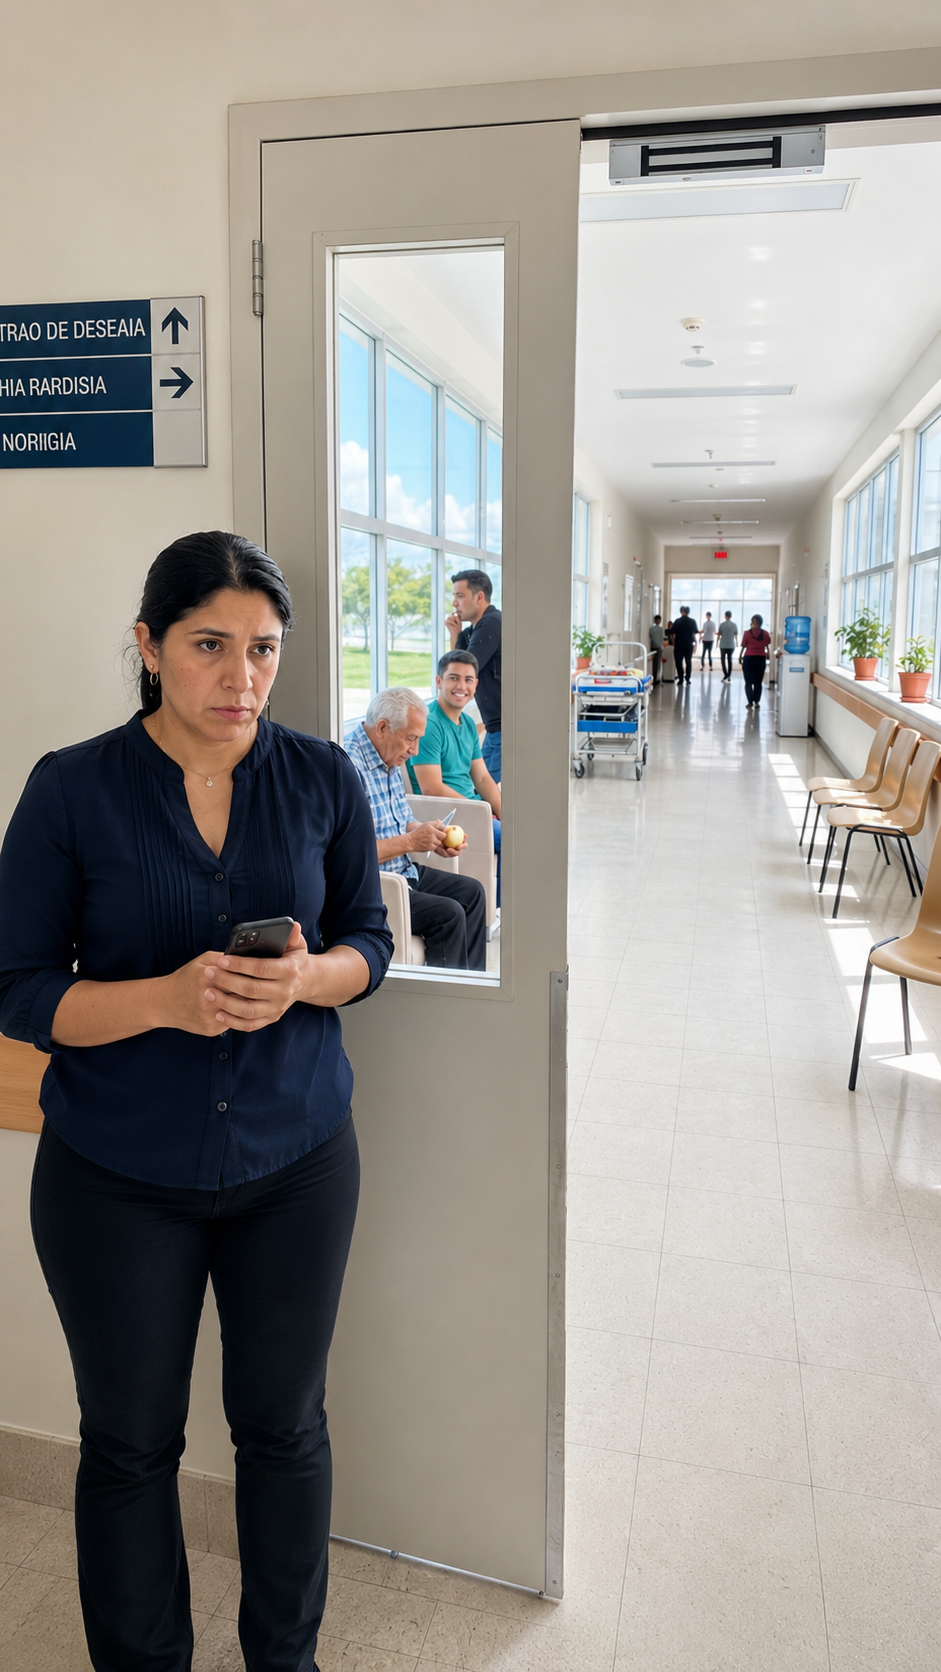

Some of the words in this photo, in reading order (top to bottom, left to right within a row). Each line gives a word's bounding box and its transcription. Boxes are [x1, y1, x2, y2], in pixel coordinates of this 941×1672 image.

[0, 322, 42, 342] TRAO
[46, 321, 69, 340] DE
[73, 317, 146, 339] DESEAIA
[0, 378, 26, 397] HIA
[29, 375, 107, 396] RARDISIA
